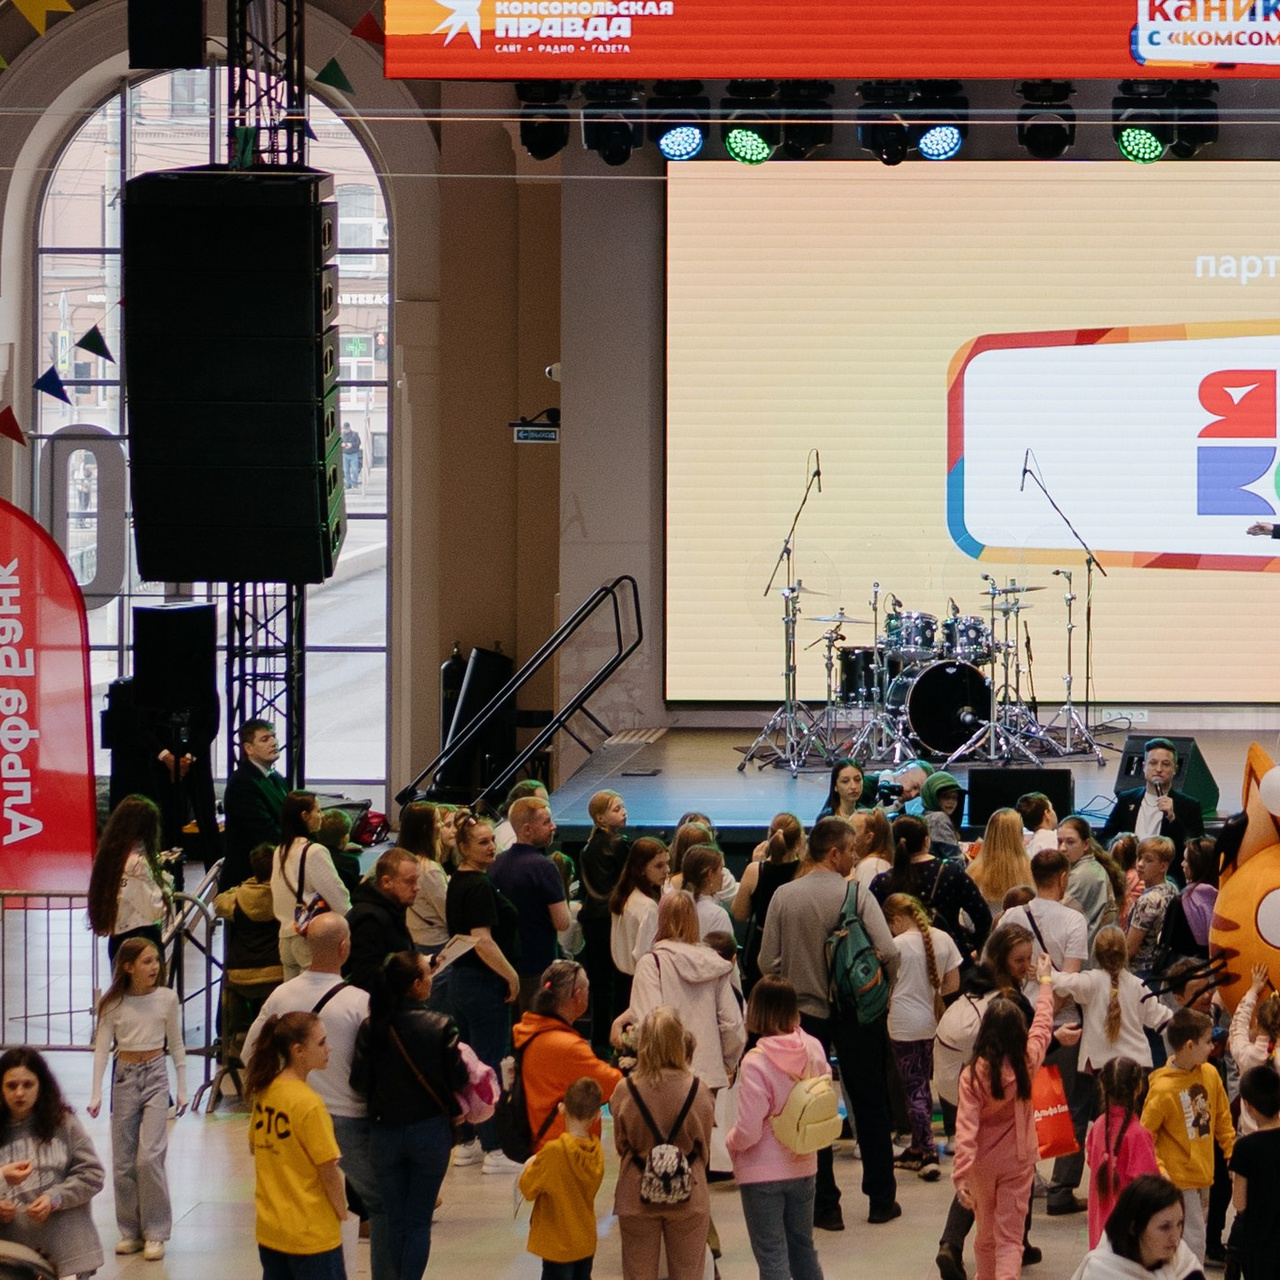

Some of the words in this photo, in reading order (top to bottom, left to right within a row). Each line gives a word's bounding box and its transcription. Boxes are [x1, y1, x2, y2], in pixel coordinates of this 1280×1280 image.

[495, 1, 674, 15] КОМСОМОЛЬСКАЯ
[495, 17, 632, 41] ПРАВДА
[495, 43, 522, 53] САЙТ
[538, 44, 575, 54] РАДИО
[591, 44, 631, 53] ГАЗЕТА
